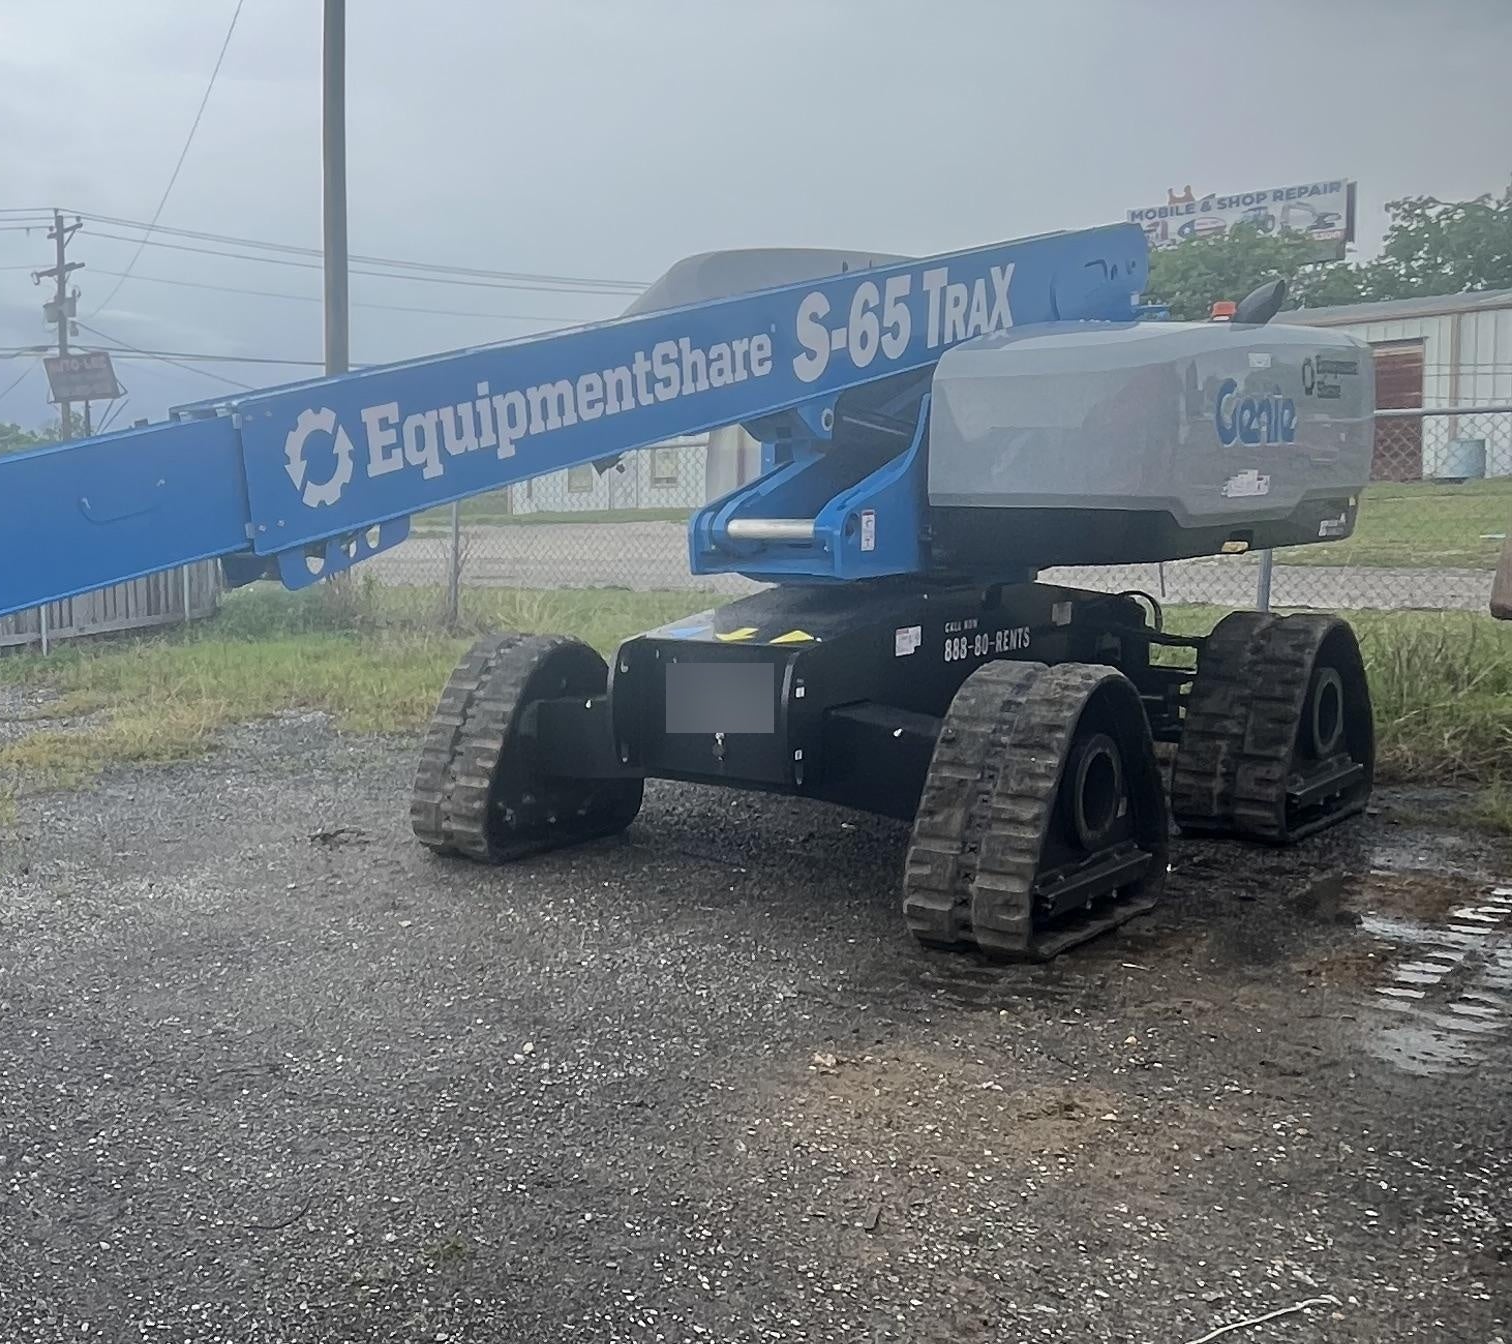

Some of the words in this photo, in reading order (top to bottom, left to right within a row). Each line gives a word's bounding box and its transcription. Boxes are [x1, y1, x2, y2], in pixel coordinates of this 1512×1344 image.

[1130, 203, 1196, 222] MOBILE
[1199, 199, 1212, 213] &
[1218, 191, 1268, 210] SHOP
[1272, 182, 1341, 202] REPAIR
[792, 273, 913, 382] S-65
[360, 333, 773, 480] EquipmentShare
[1216, 377, 1297, 446] Genie
[944, 626, 1030, 663] 888-80-RENTS
